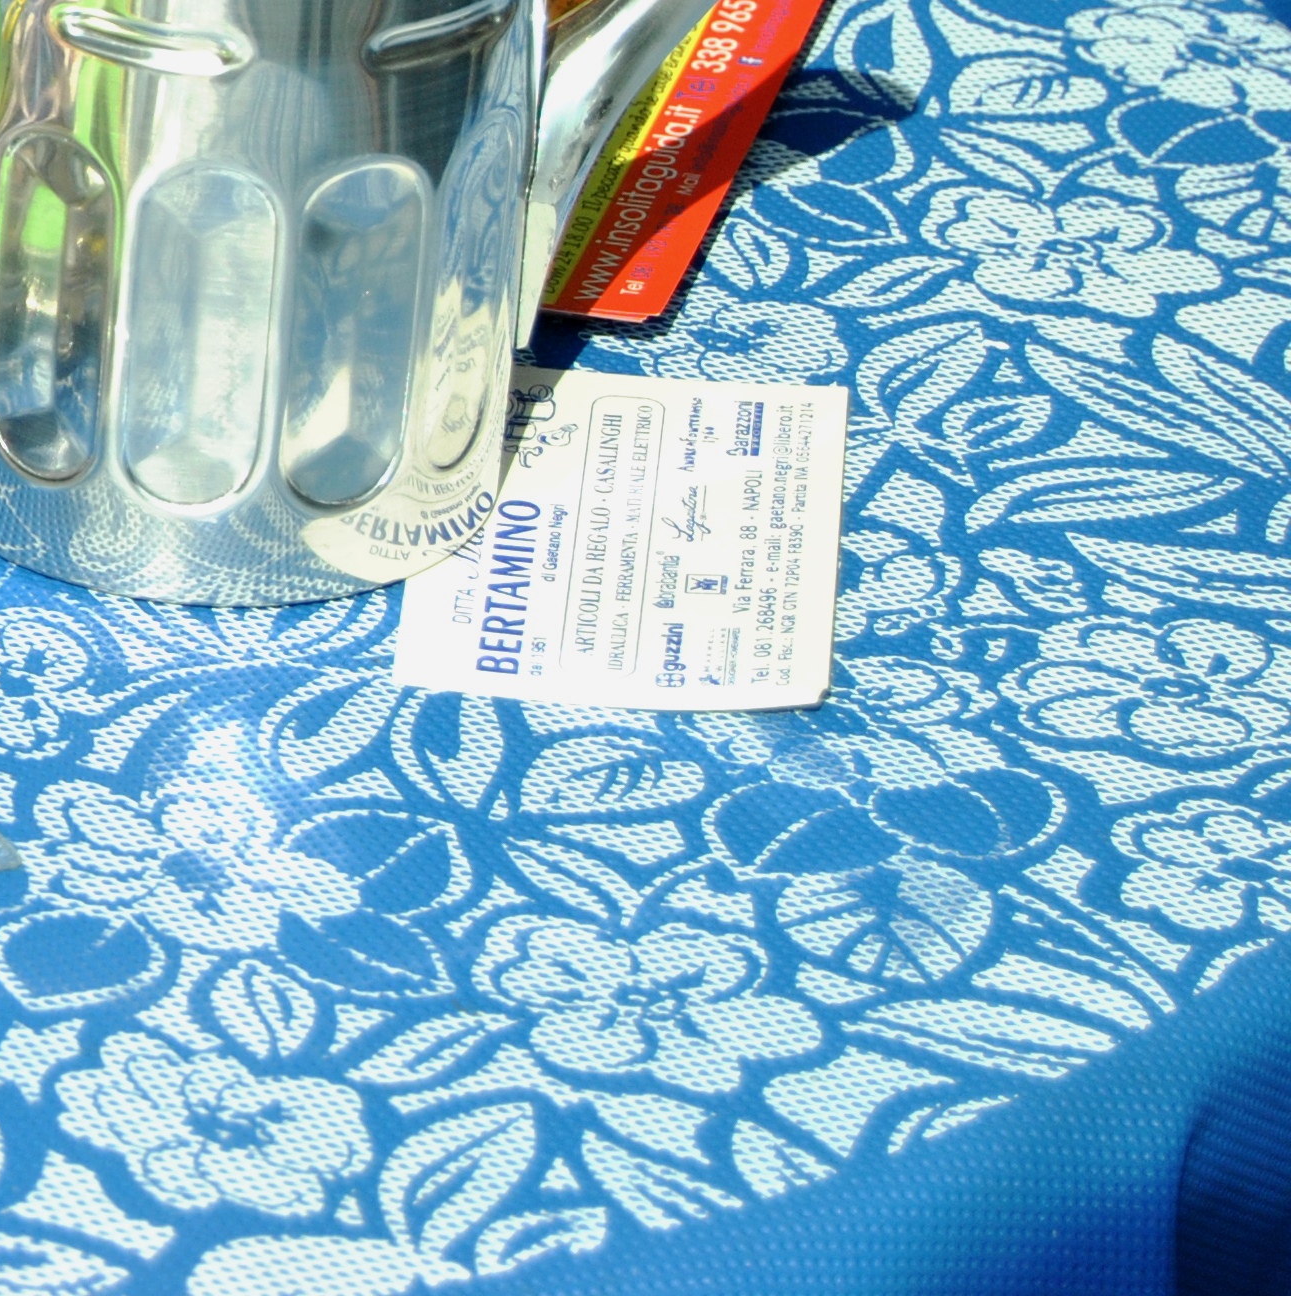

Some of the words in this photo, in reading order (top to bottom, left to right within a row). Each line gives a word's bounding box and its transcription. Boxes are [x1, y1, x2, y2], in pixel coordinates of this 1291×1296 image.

[573, 104, 703, 301] www.insolitaguida.it
[691, 36, 738, 73] 338
[567, 215, 594, 247] 18.00
[620, 279, 645, 295] Tel
[676, 172, 701, 197] Mail
[631, 404, 653, 461] ELETTRICO
[592, 413, 623, 493] CASALINGHI
[766, 404, 796, 529] gaetano.negri@libero.it
[794, 466, 808, 479] IVA
[741, 469, 762, 510] NAPOLI
[791, 483, 807, 512] Partita
[546, 503, 569, 528] Negri
[584, 506, 611, 561] REGALO
[739, 524, 757, 539] 88
[541, 531, 563, 570] Gaetano
[614, 531, 638, 602] FERRAMENTA
[734, 544, 757, 590] Ferrara,
[761, 533, 781, 572] e-mail:
[477, 498, 541, 674] BERTAMINO
[540, 573, 556, 581] di
[581, 565, 604, 585] DA
[659, 554, 679, 599] brabantia
[784, 557, 801, 587] 72P04
[451, 588, 476, 624] DITTA
[571, 589, 602, 655] ARTICOLI
[732, 595, 751, 614] Via
[753, 586, 777, 657] 081.268496
[780, 613, 795, 633] NGR
[529, 636, 546, 657] 1951
[606, 611, 629, 670] IDRAULICA
[661, 622, 686, 671] guzzini
[750, 662, 769, 684] Tel.
[775, 665, 791, 685] Cod.
